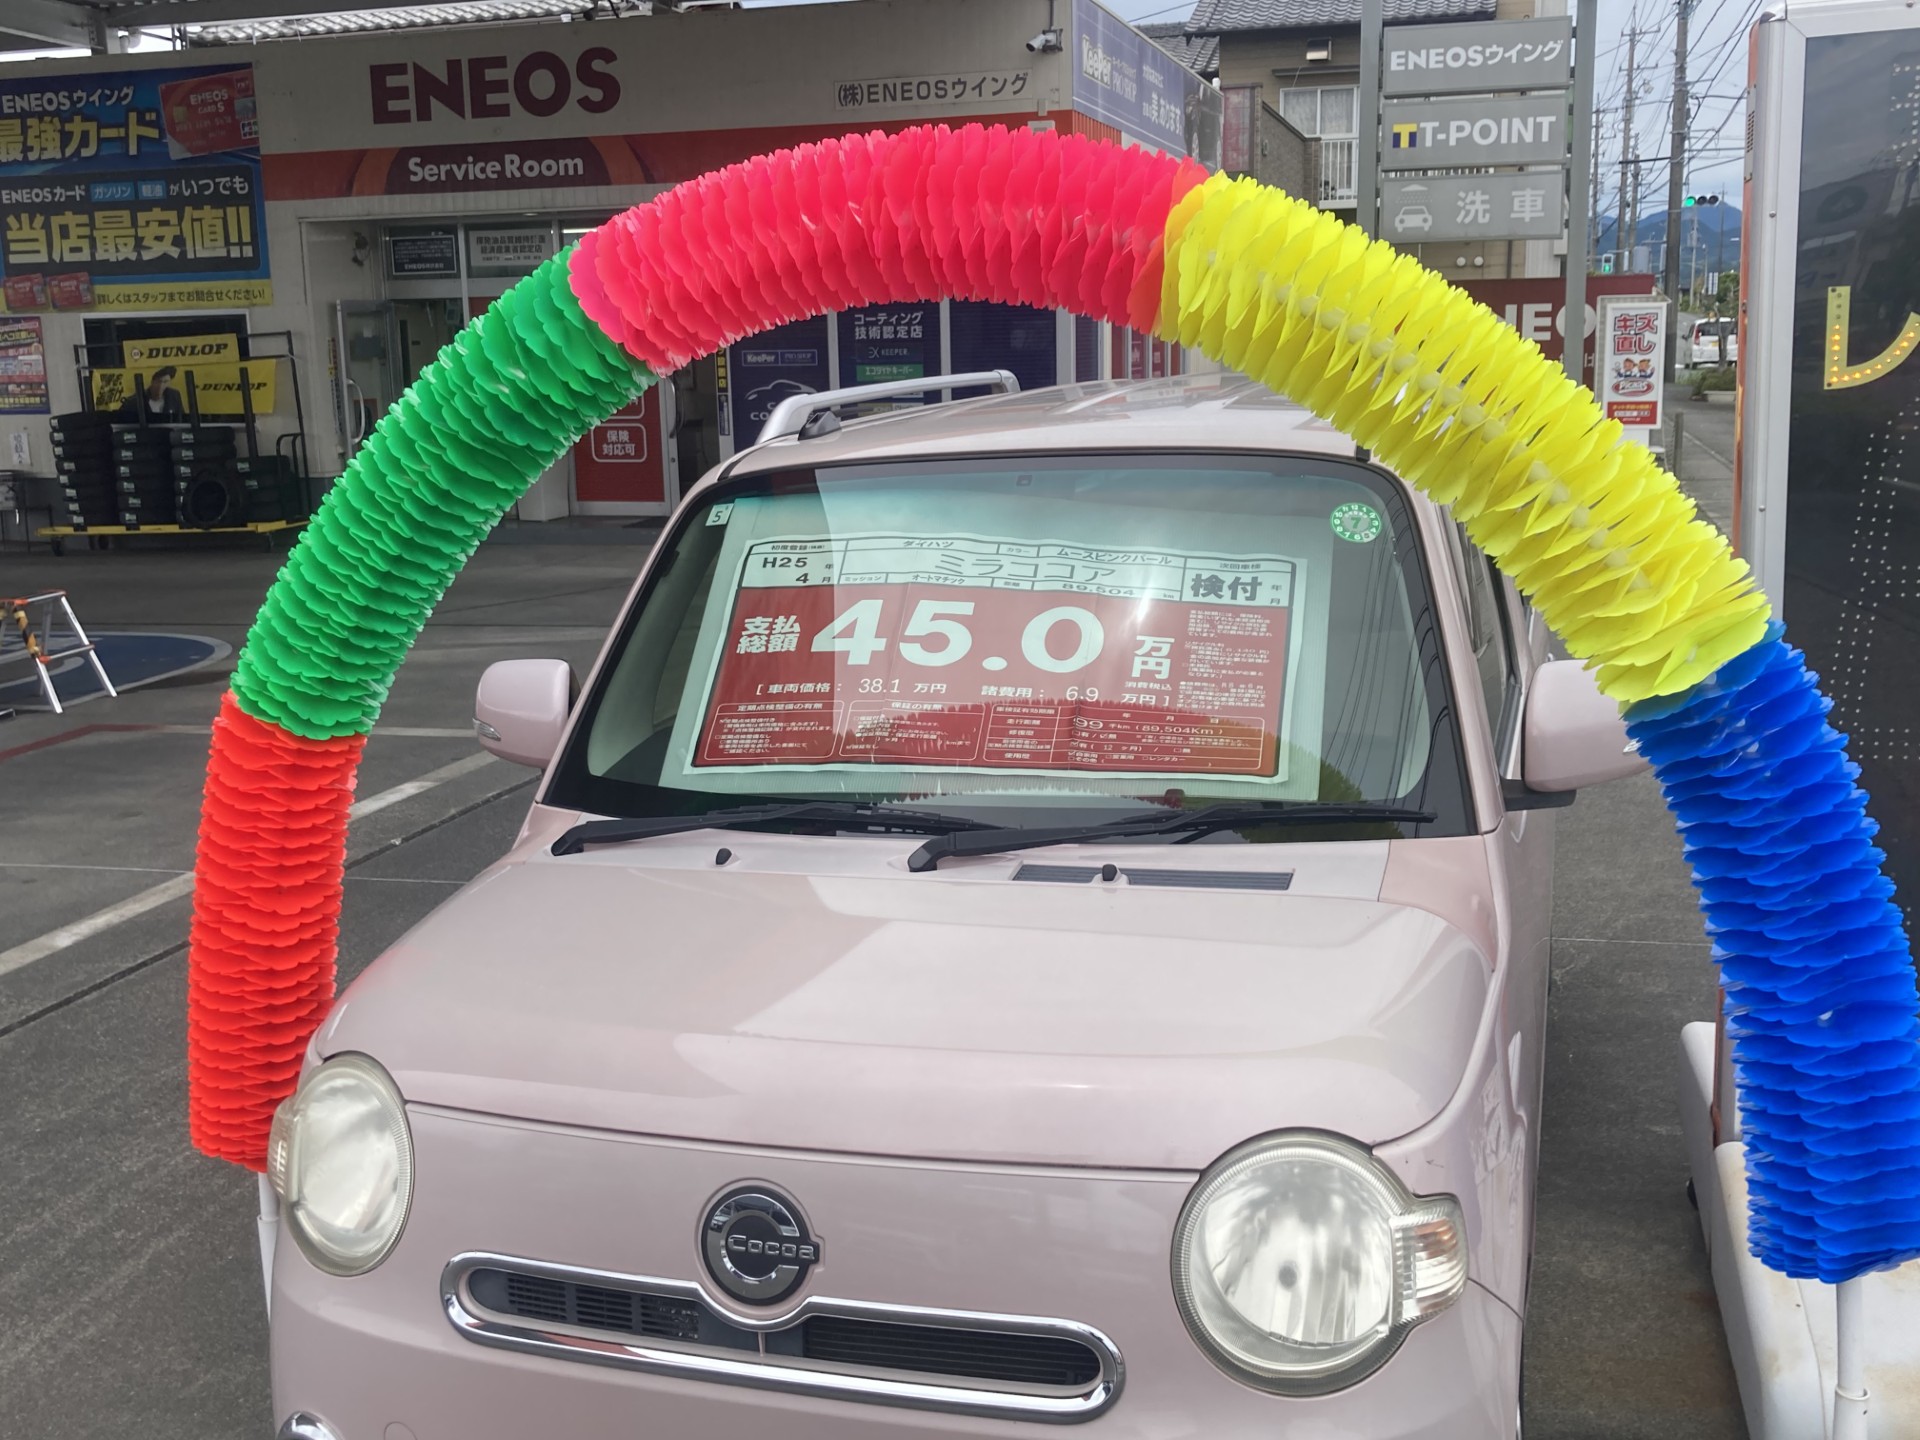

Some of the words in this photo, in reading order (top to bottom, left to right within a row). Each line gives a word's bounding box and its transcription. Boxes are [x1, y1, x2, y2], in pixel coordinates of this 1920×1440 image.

[1390, 40, 1564, 71] ENEOSウイング
[369, 47, 621, 125] ENEOS
[838, 72, 1029, 108] (株)ENEOSウイング
[3, 85, 134, 114] ENEOSウイング
[0, 111, 159, 163] 最強カード
[1419, 115, 1557, 147] T-POINT
[408, 156, 501, 182] Service
[504, 154, 584, 178] Room
[2, 185, 86, 204] ENEOSカード
[1456, 188, 1546, 225] 洗車
[6, 205, 254, 264] 当店最安値!!
[854, 311, 924, 325] コーティング
[1614, 312, 1658, 335] キズ
[854, 325, 923, 340] 技術認定店
[145, 343, 229, 359] DUNLOP
[1614, 333, 1657, 355] 直し
[606, 430, 630, 443] 保険
[602, 444, 636, 456] 対応可
[712, 511, 723, 523] 5
[903, 540, 955, 548] ダイハツ
[762, 556, 808, 568] H25
[935, 553, 1117, 582] ミラココア
[1056, 548, 1172, 566] ムースピンクパール
[795, 573, 809, 583] 4
[1190, 573, 1262, 601] 検付
[741, 615, 801, 635] 支払
[811, 599, 1104, 673] 45.0
[736, 633, 800, 654] 総額
[858, 678, 900, 694] 38.1
[913, 683, 947, 694] 万円
[1066, 686, 1099, 702] 6.9
[1121, 693, 1157, 705] 万円
